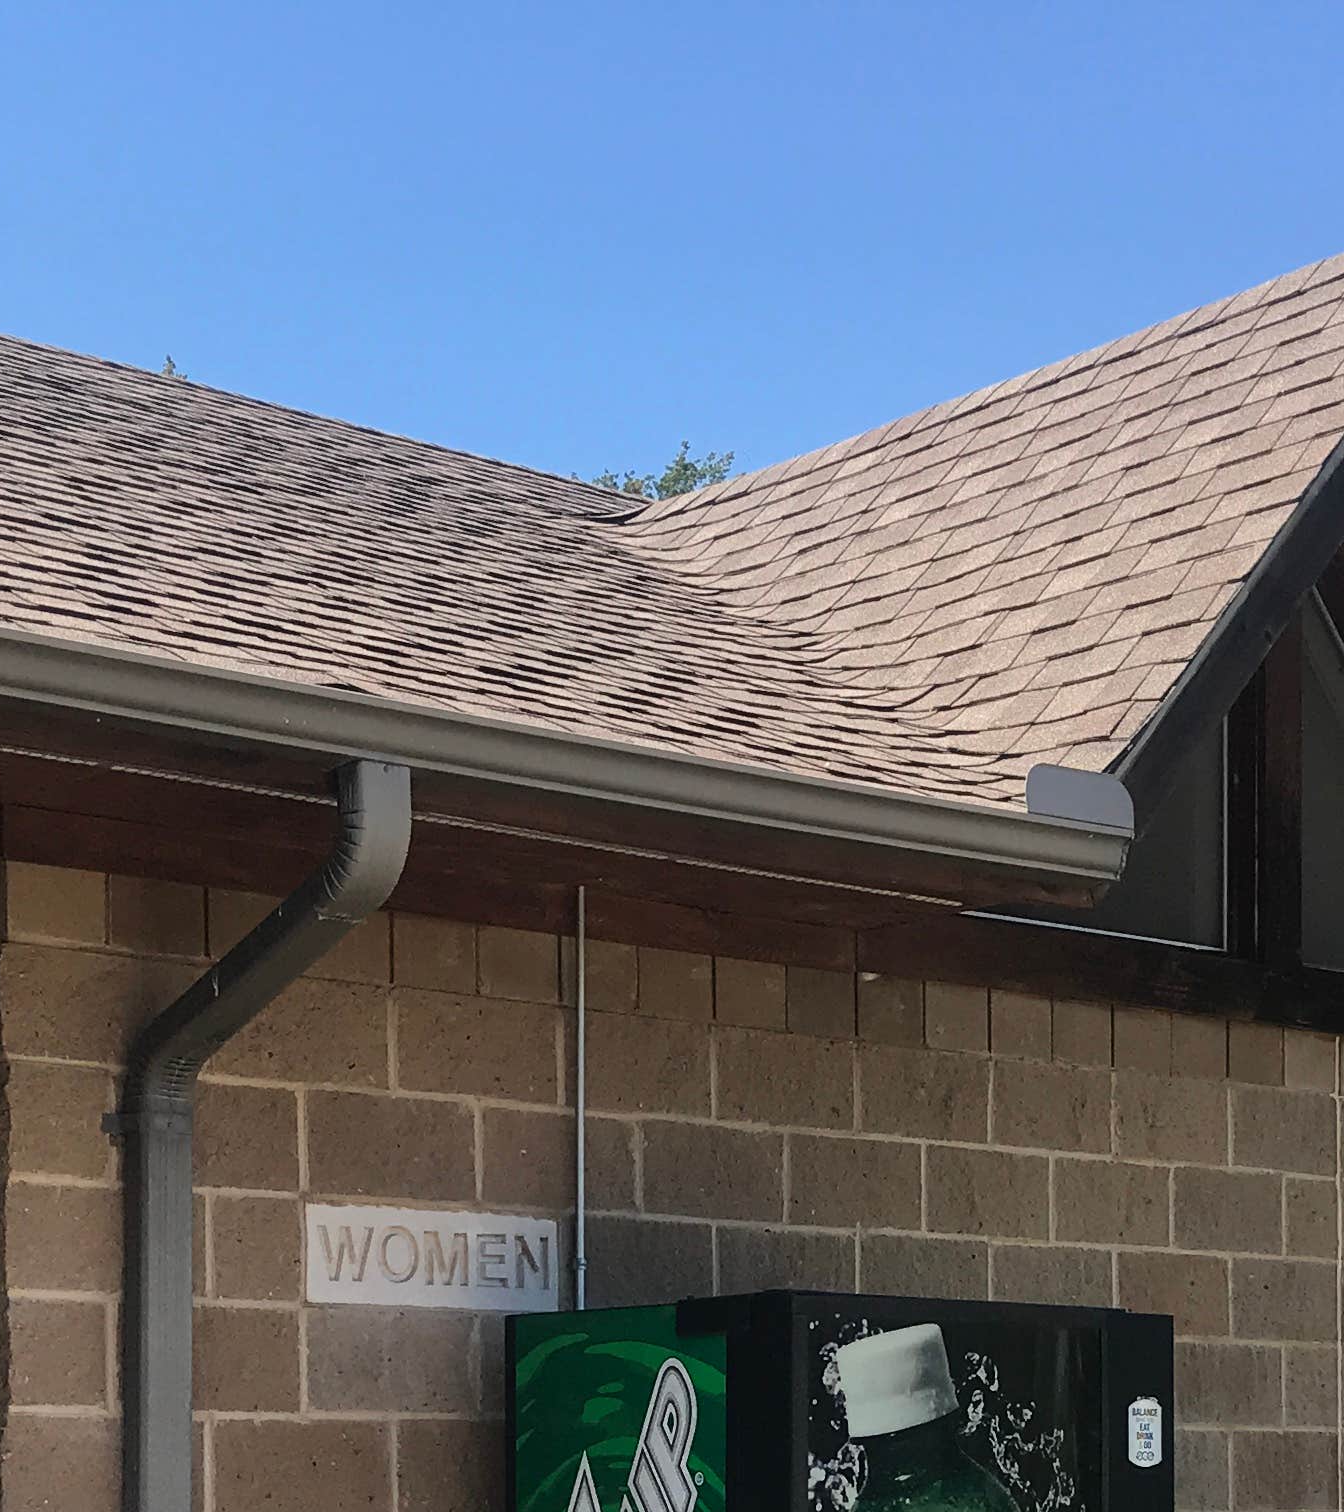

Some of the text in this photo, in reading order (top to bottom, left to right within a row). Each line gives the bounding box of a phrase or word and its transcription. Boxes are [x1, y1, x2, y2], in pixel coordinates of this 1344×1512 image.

[317, 1224, 550, 1290] WOMEN
[1132, 1408, 1158, 1416] BALANCE
[1139, 1423, 1150, 1431] EAT
